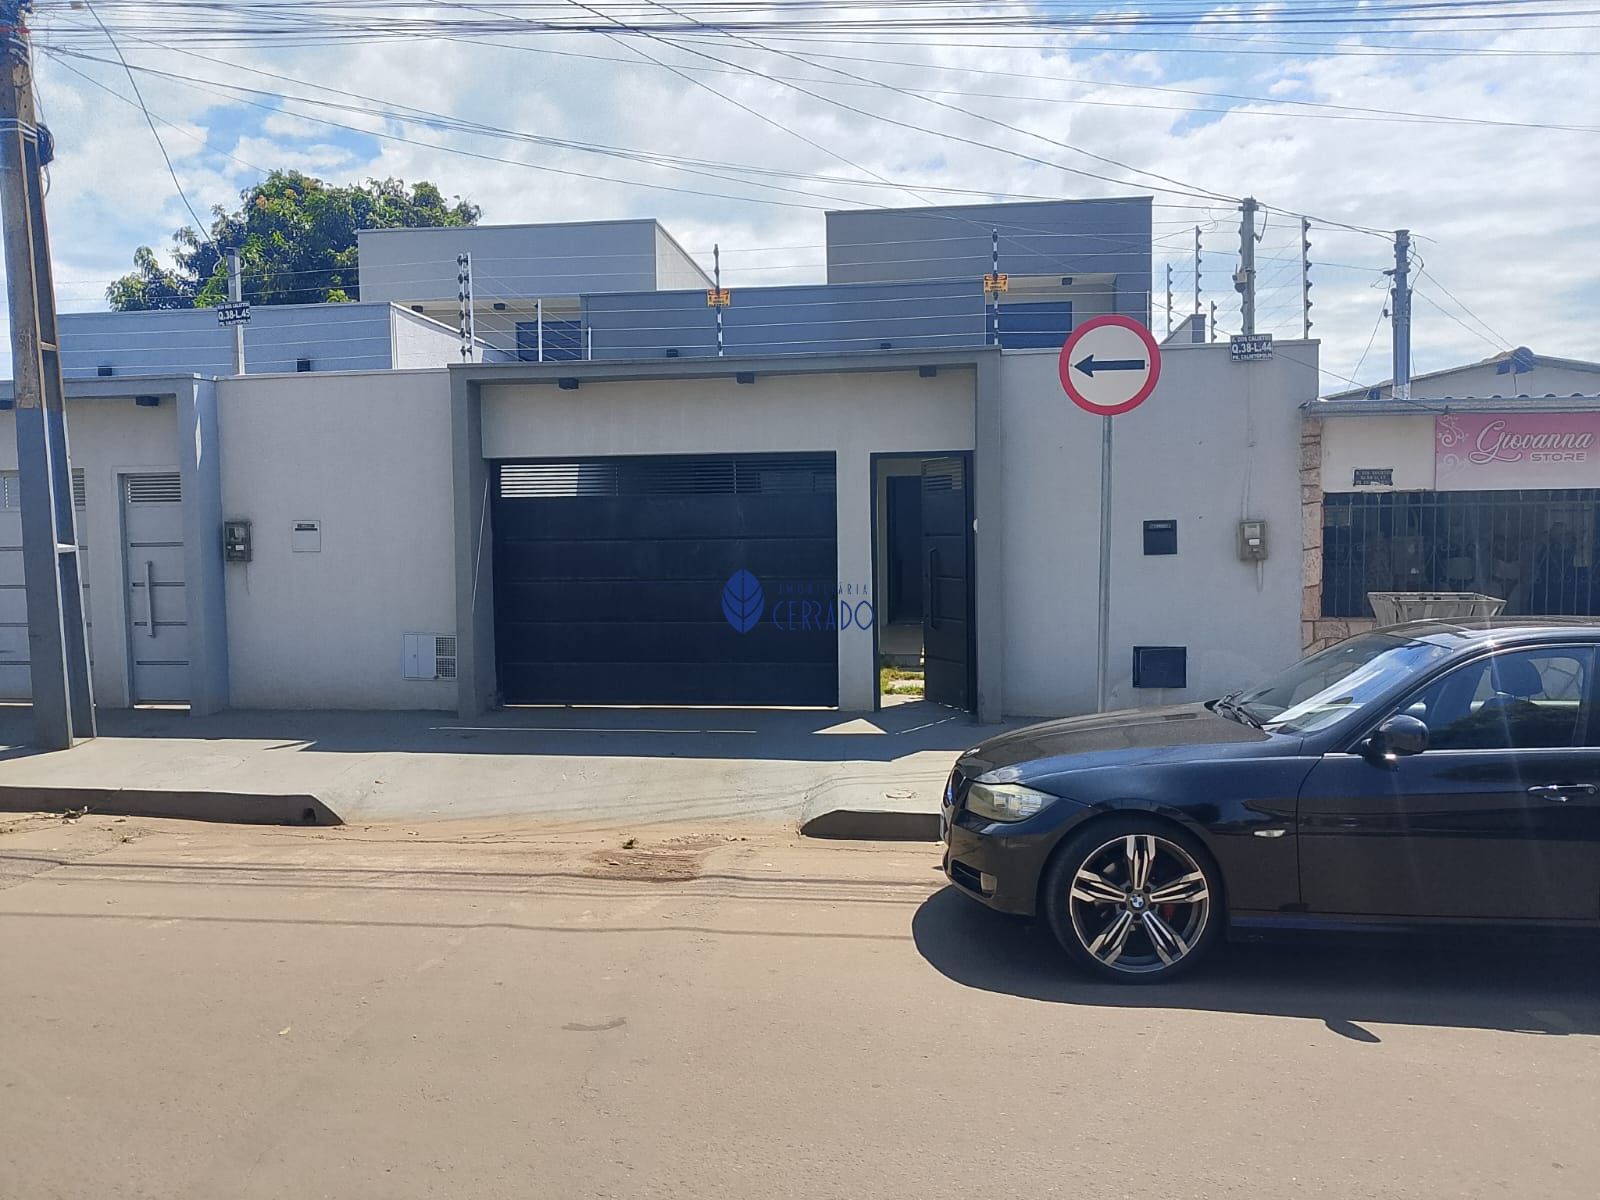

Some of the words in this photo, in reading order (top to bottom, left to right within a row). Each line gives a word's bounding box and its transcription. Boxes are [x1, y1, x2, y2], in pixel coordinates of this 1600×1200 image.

[217, 309, 250, 321] Q.38-L.45
[1231, 342, 1272, 354] Q.38-L.44
[1468, 420, 1595, 464] Giovanna
[1531, 452, 1585, 462] STORE
